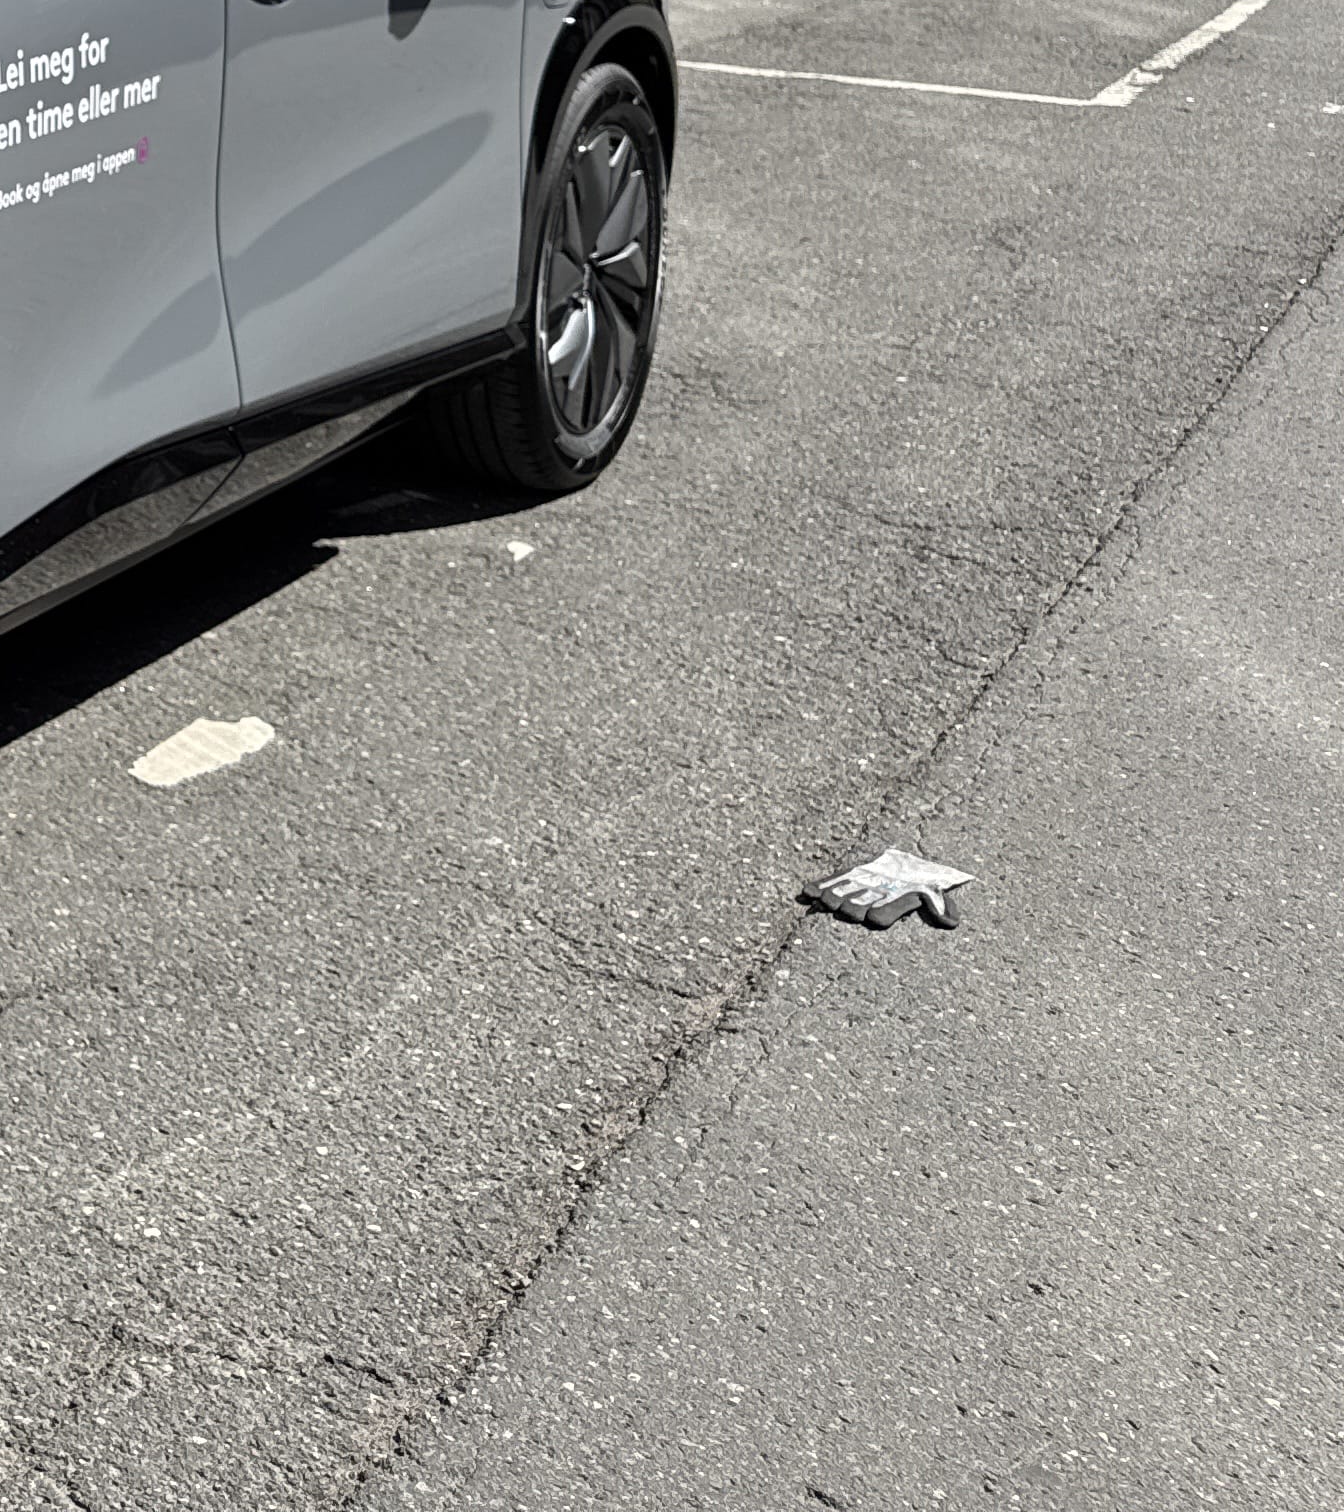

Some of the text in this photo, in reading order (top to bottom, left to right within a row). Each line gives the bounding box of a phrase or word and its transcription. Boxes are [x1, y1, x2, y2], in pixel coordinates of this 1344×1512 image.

[30, 47, 74, 84] meg
[78, 32, 109, 68] for
[26, 100, 74, 139] time
[78, 84, 120, 123] eller
[124, 75, 161, 109] mer
[25, 181, 40, 203] og
[42, 172, 69, 197] åpne
[72, 161, 95, 183] meg
[96, 154, 102, 174] i
[102, 148, 135, 175] appen
